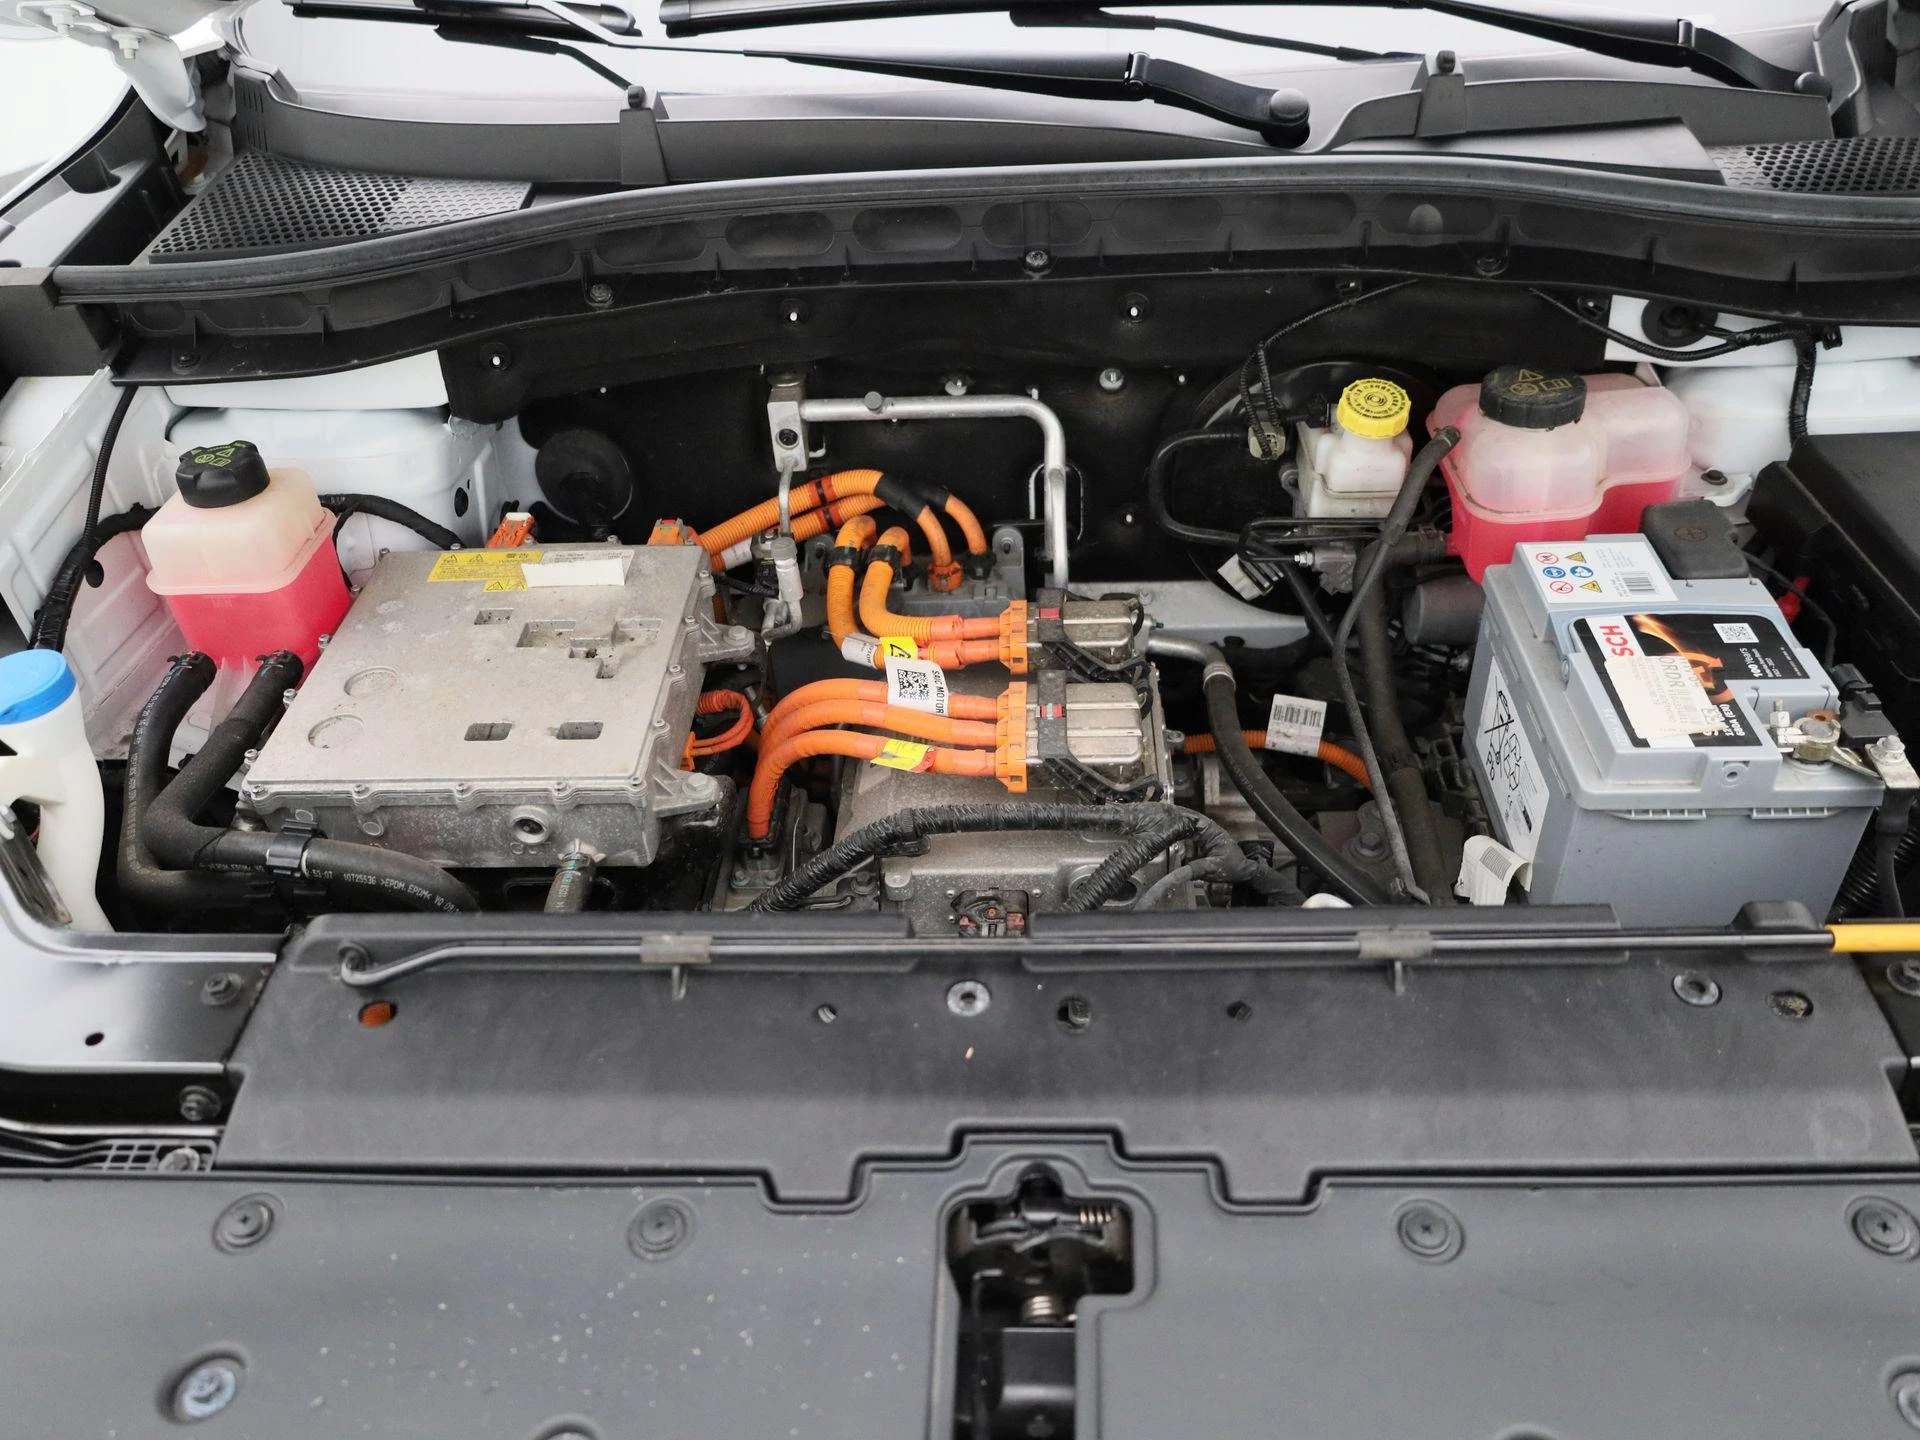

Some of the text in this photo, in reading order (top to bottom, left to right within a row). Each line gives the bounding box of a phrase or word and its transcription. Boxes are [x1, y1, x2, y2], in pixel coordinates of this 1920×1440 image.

[1599, 625, 1635, 657] SCH
[931, 669, 945, 714] SAIC MOTOR
[1718, 703, 1736, 719] (EN)
[343, 872, 377, 886] 10725536
